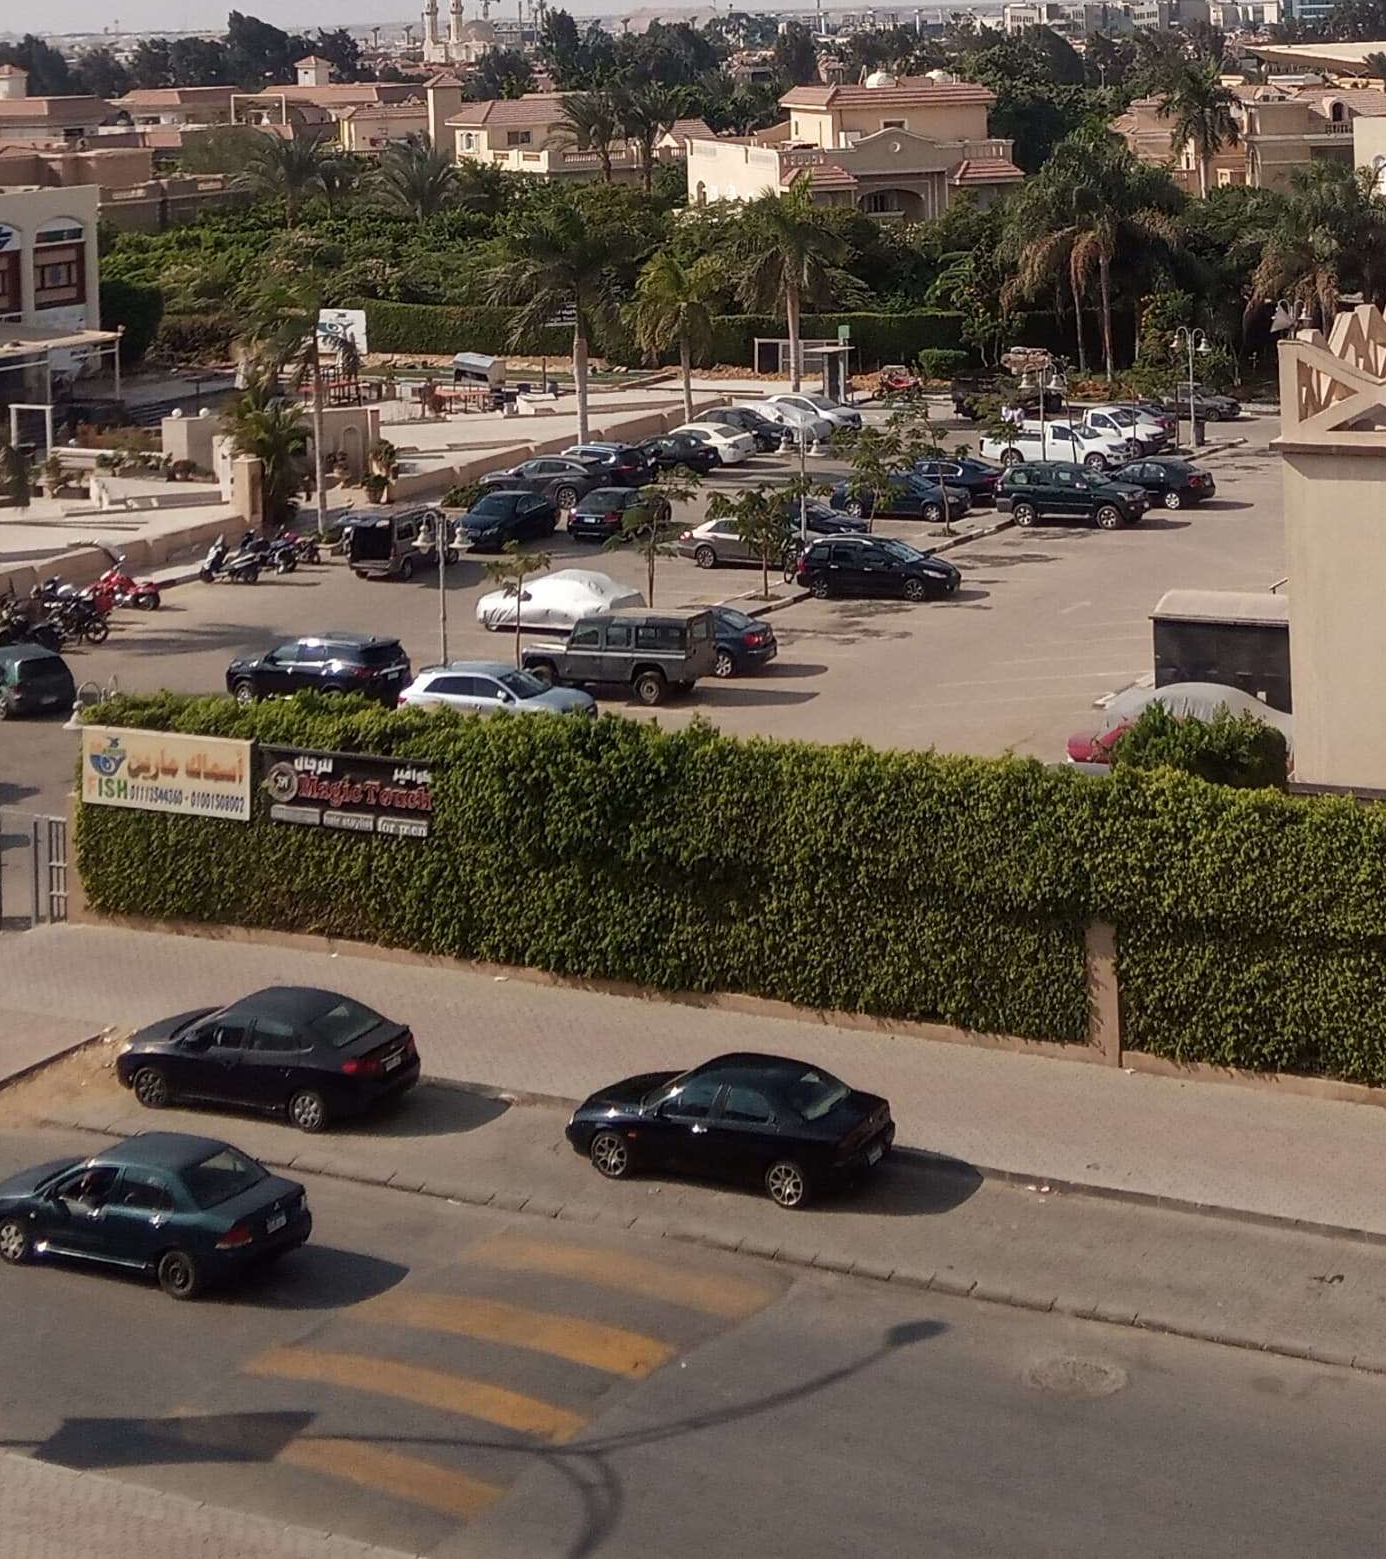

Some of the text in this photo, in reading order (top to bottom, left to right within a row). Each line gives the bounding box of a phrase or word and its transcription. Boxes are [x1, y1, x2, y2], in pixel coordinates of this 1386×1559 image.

[185, 749, 244, 785] أسماك
[88, 775, 128, 800] FISH
[298, 774, 434, 811] Magic Touch
[377, 816, 395, 833] for
